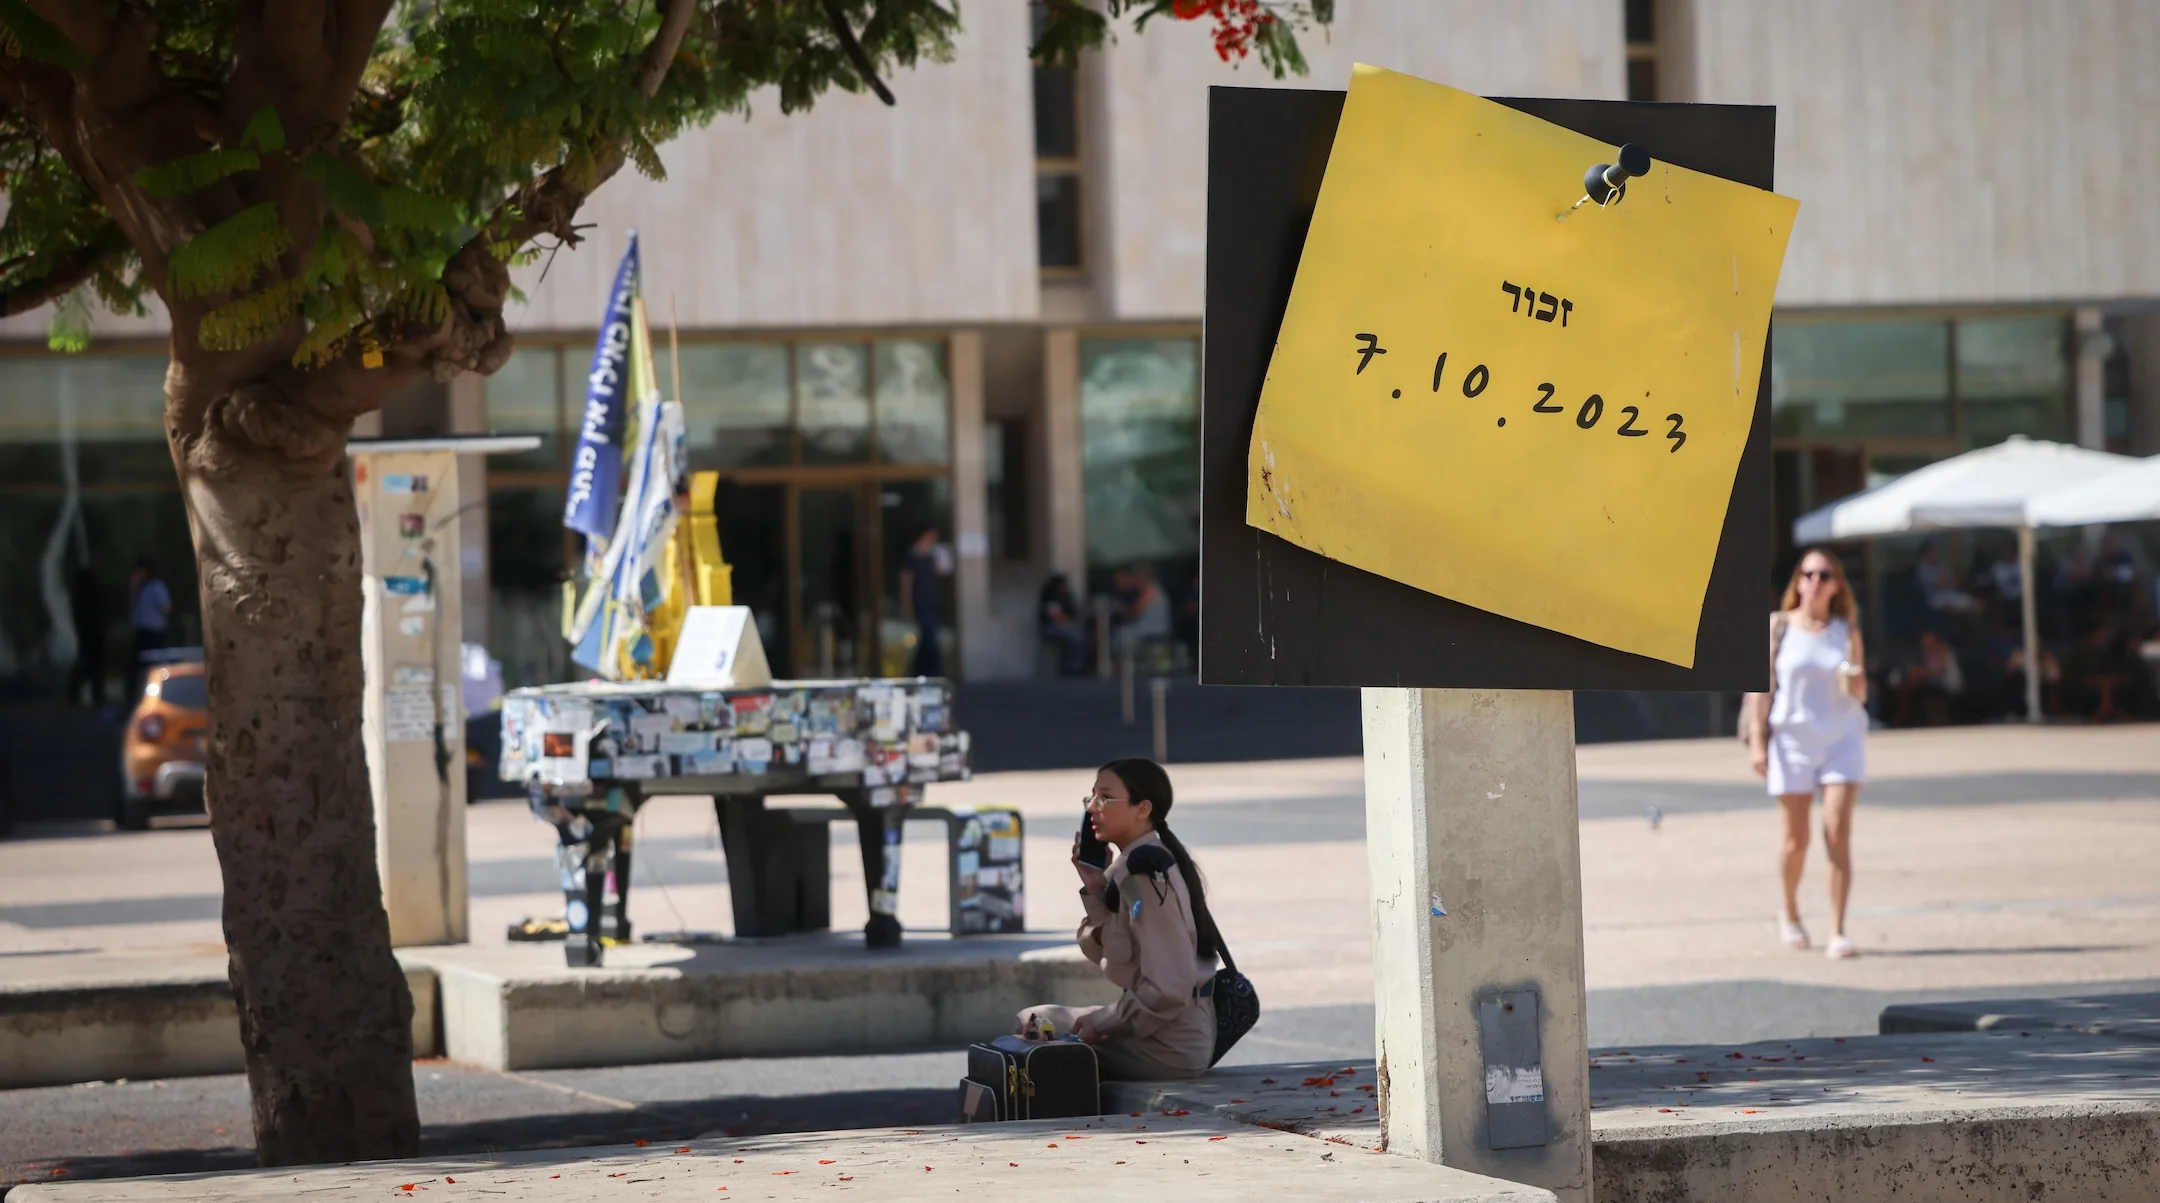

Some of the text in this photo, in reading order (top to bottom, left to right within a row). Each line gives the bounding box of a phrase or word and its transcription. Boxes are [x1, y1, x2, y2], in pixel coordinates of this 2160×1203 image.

[1501, 280, 1574, 328] זכור
[1354, 333, 1688, 454] 7.10.2023
[581, 398, 610, 445] אין
